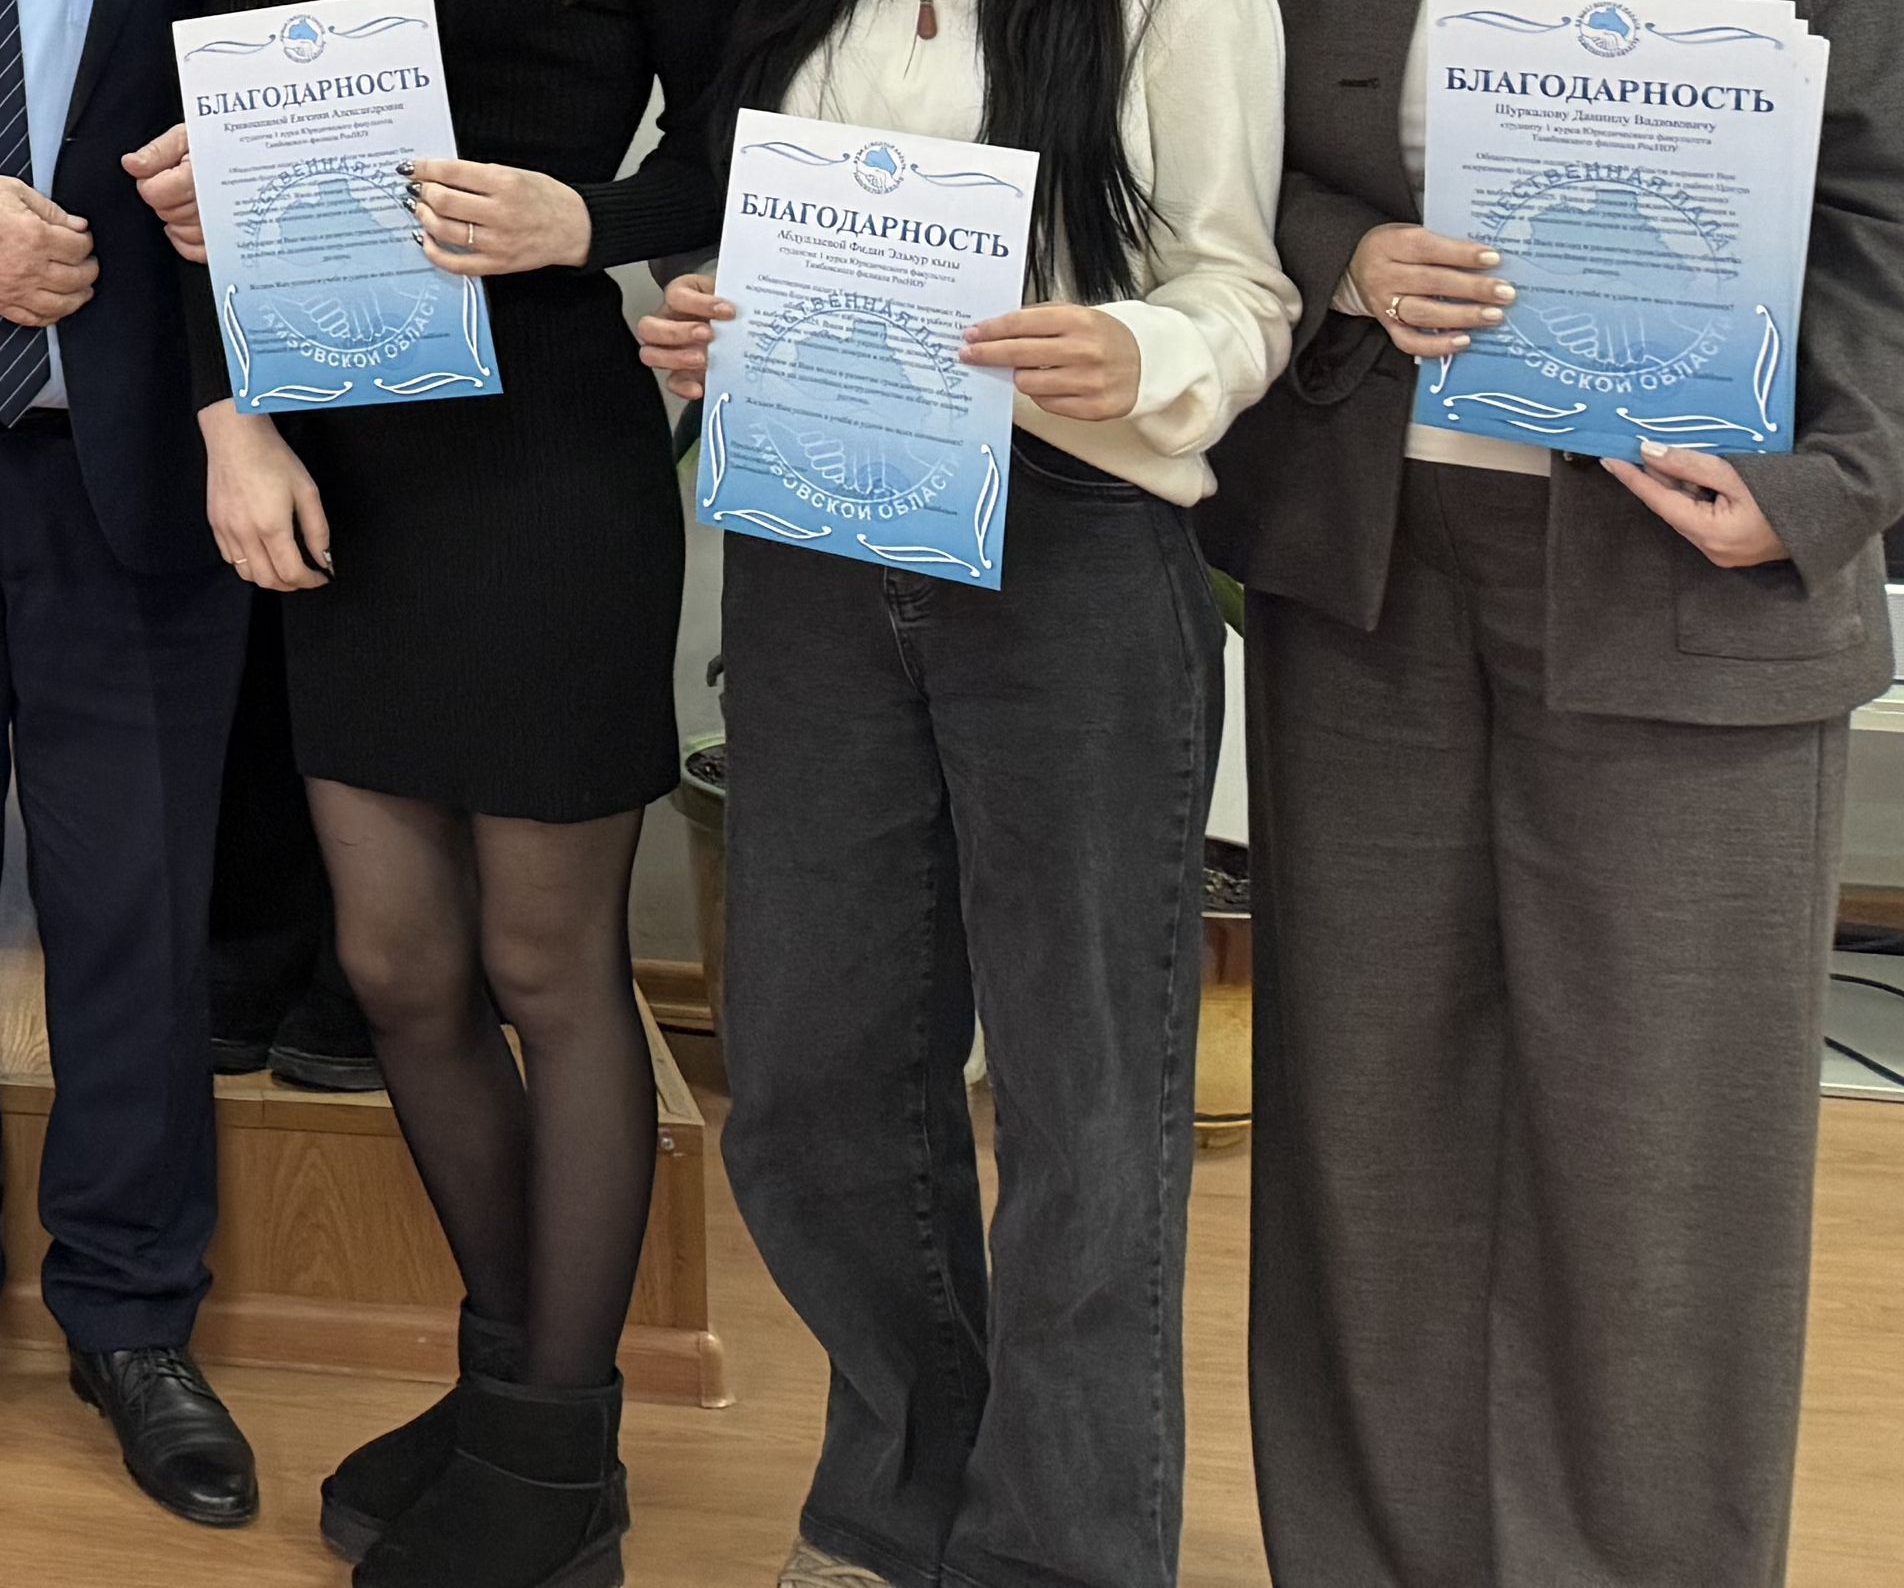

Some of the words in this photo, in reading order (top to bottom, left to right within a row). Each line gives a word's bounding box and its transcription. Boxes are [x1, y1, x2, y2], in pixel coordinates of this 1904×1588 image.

[196, 66, 431, 117] БЛАГОДАРНОСТЬ
[1445, 66, 1775, 114] БЛАГОДАРНОСТЬ
[739, 192, 1011, 259] БЛАГОДАРНОСТЬ
